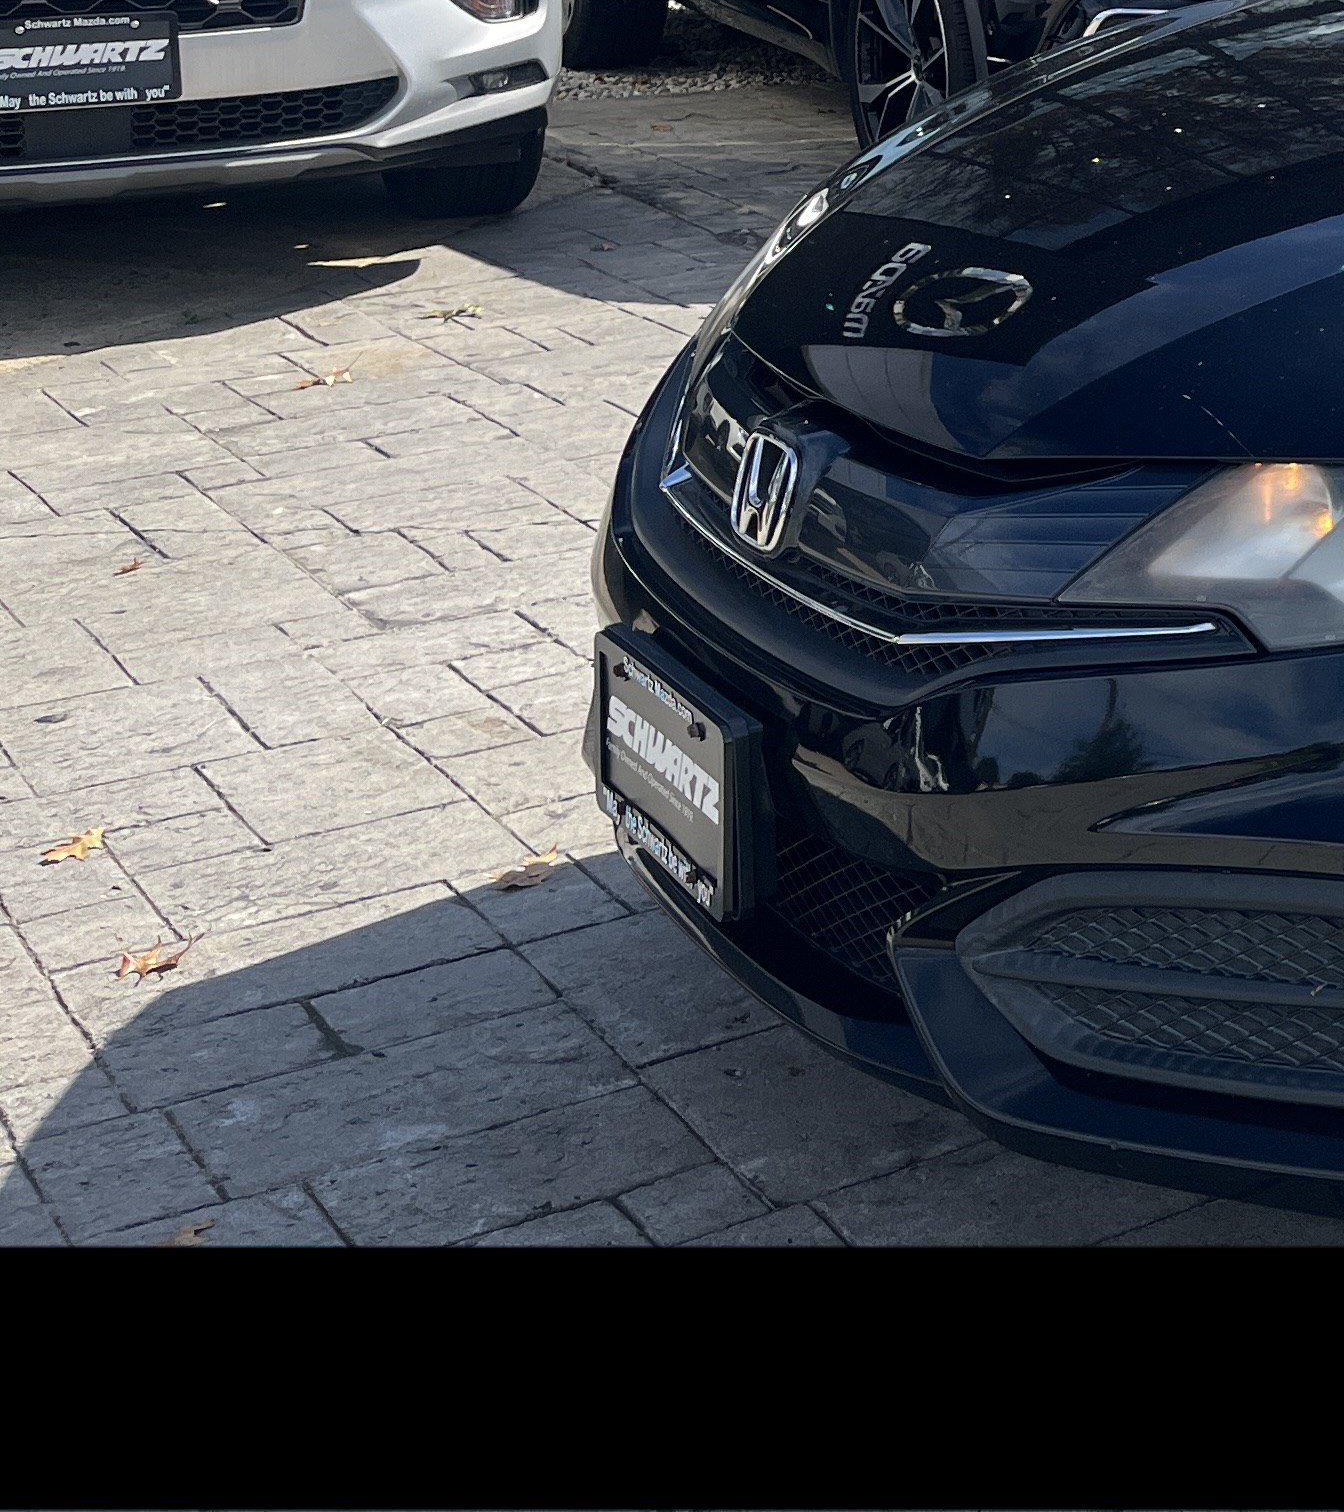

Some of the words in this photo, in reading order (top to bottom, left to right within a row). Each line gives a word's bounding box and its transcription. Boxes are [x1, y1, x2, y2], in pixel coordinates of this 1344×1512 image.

[24, 18, 71, 30] Schwartz
[73, 16, 130, 27] Mazda.com
[29, 93, 47, 107] the
[49, 89, 98, 105] Schwartz
[100, 88, 113, 102] be
[113, 87, 139, 101] with
[622, 655, 654, 694] Schwartz
[654, 680, 693, 724] Mazda.com
[607, 695, 720, 825] SCHWARTZ
[626, 804, 637, 834] the
